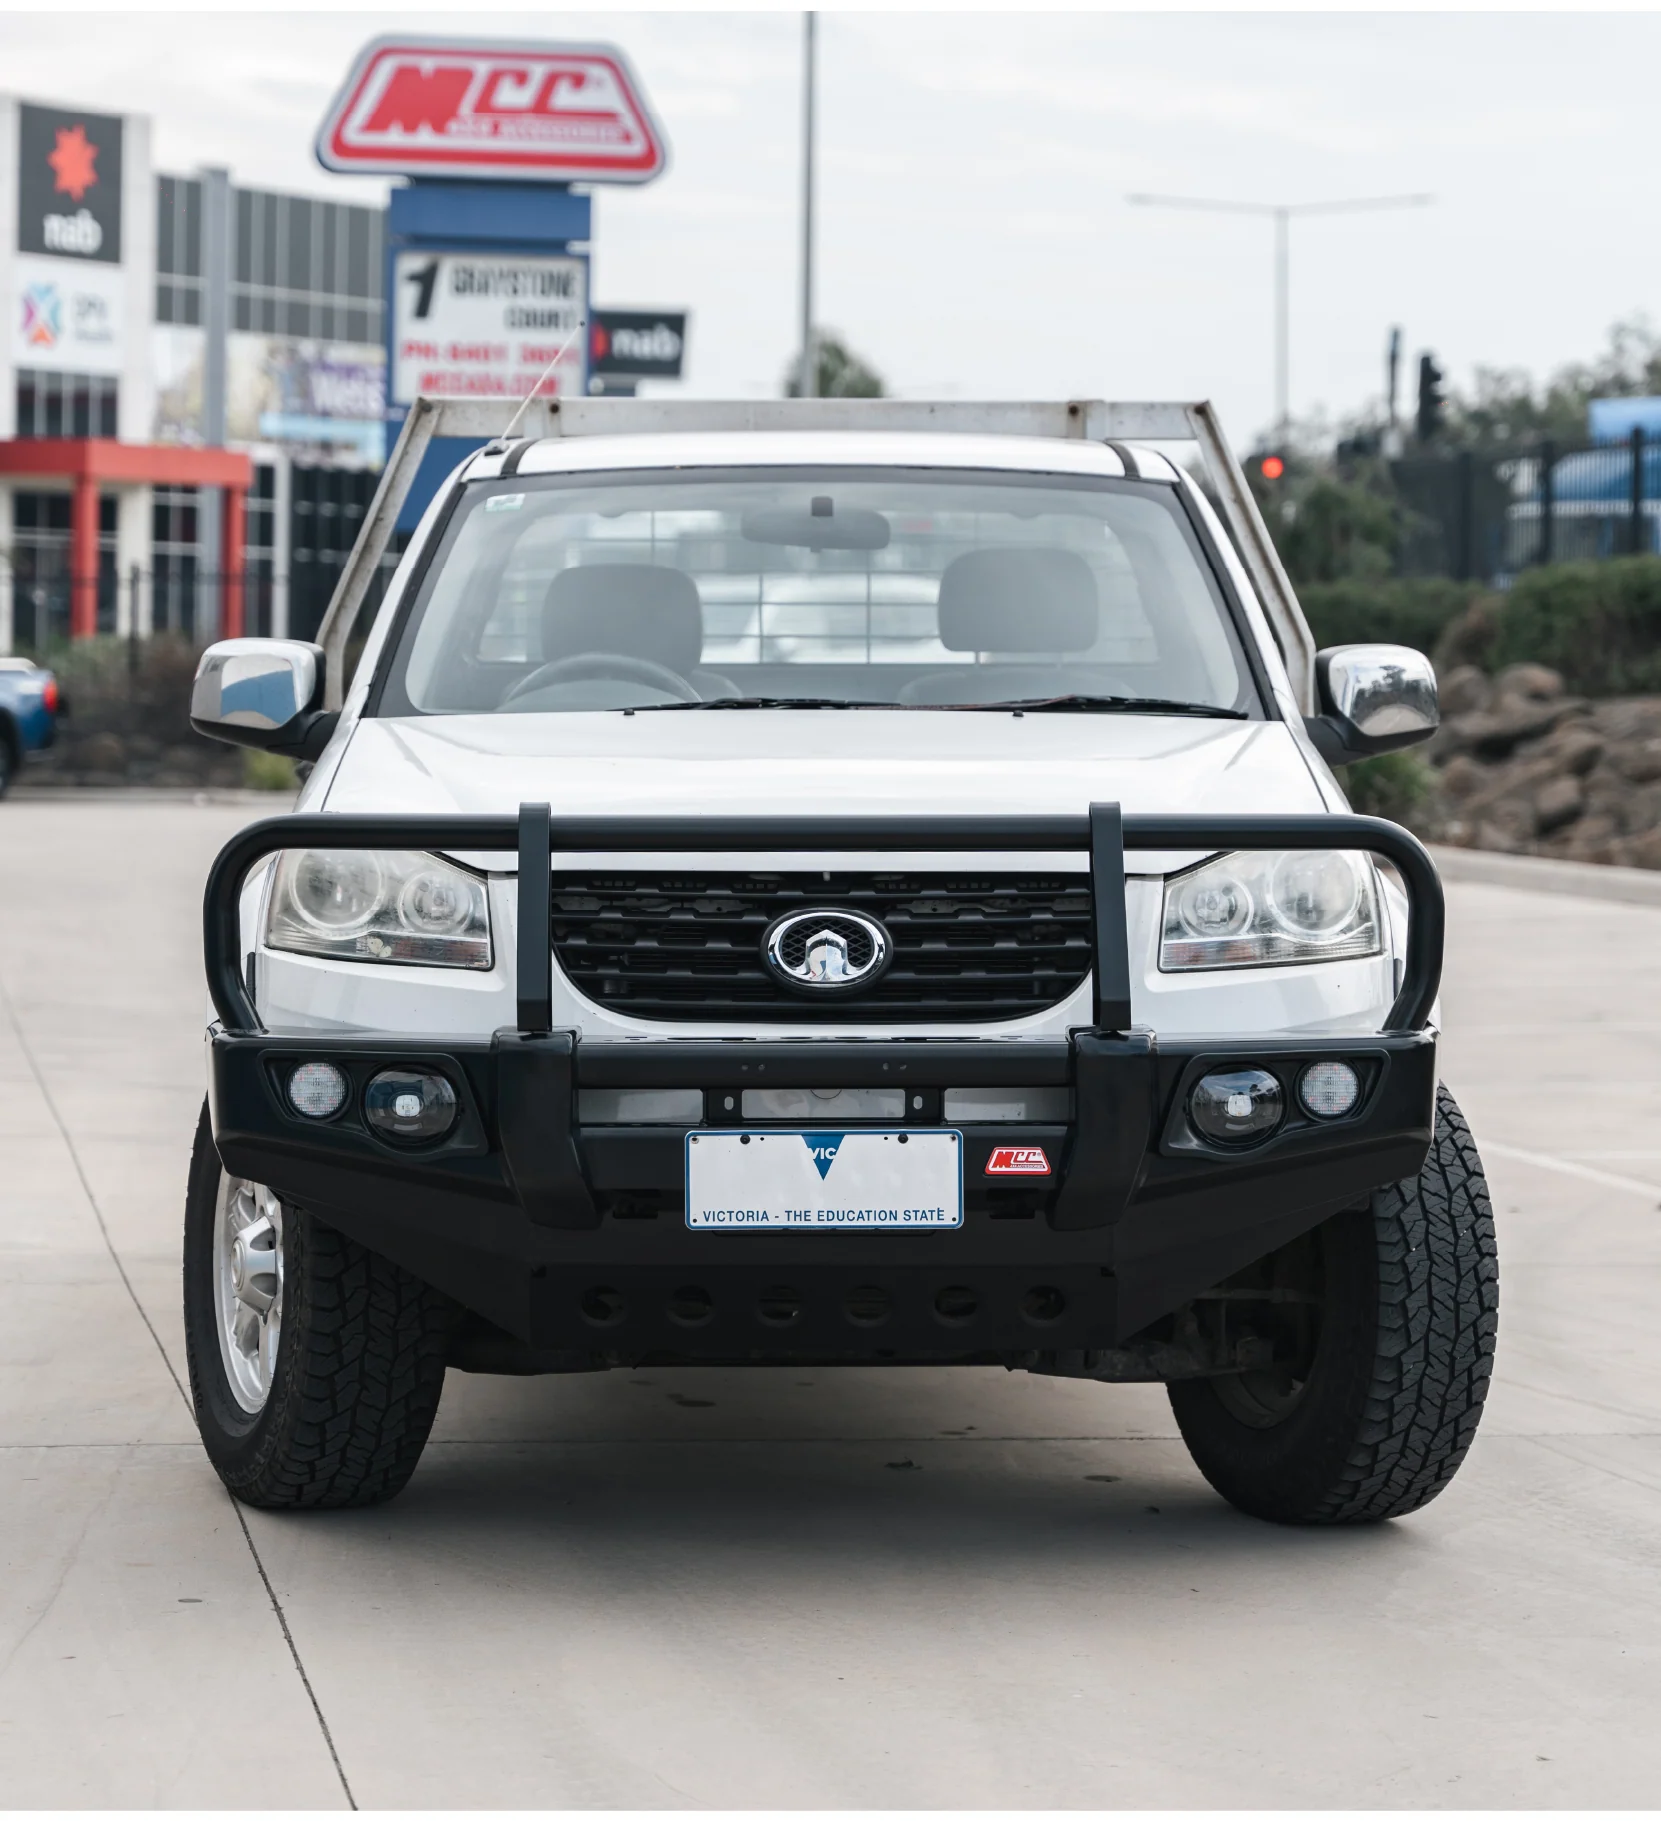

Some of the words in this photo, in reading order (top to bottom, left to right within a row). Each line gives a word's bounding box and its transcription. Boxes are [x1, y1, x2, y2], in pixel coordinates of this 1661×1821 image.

[359, 65, 619, 134] MCC
[44, 208, 102, 253] nab
[406, 258, 440, 319] 1
[611, 323, 681, 361] nab
[811, 1147, 837, 1160] VIC
[991, 1151, 1043, 1168] MCC
[703, 1210, 769, 1222] VICTORIA
[785, 1210, 811, 1222] THE
[817, 1210, 899, 1222] EDUCATION
[903, 1208, 945, 1222] STATE
